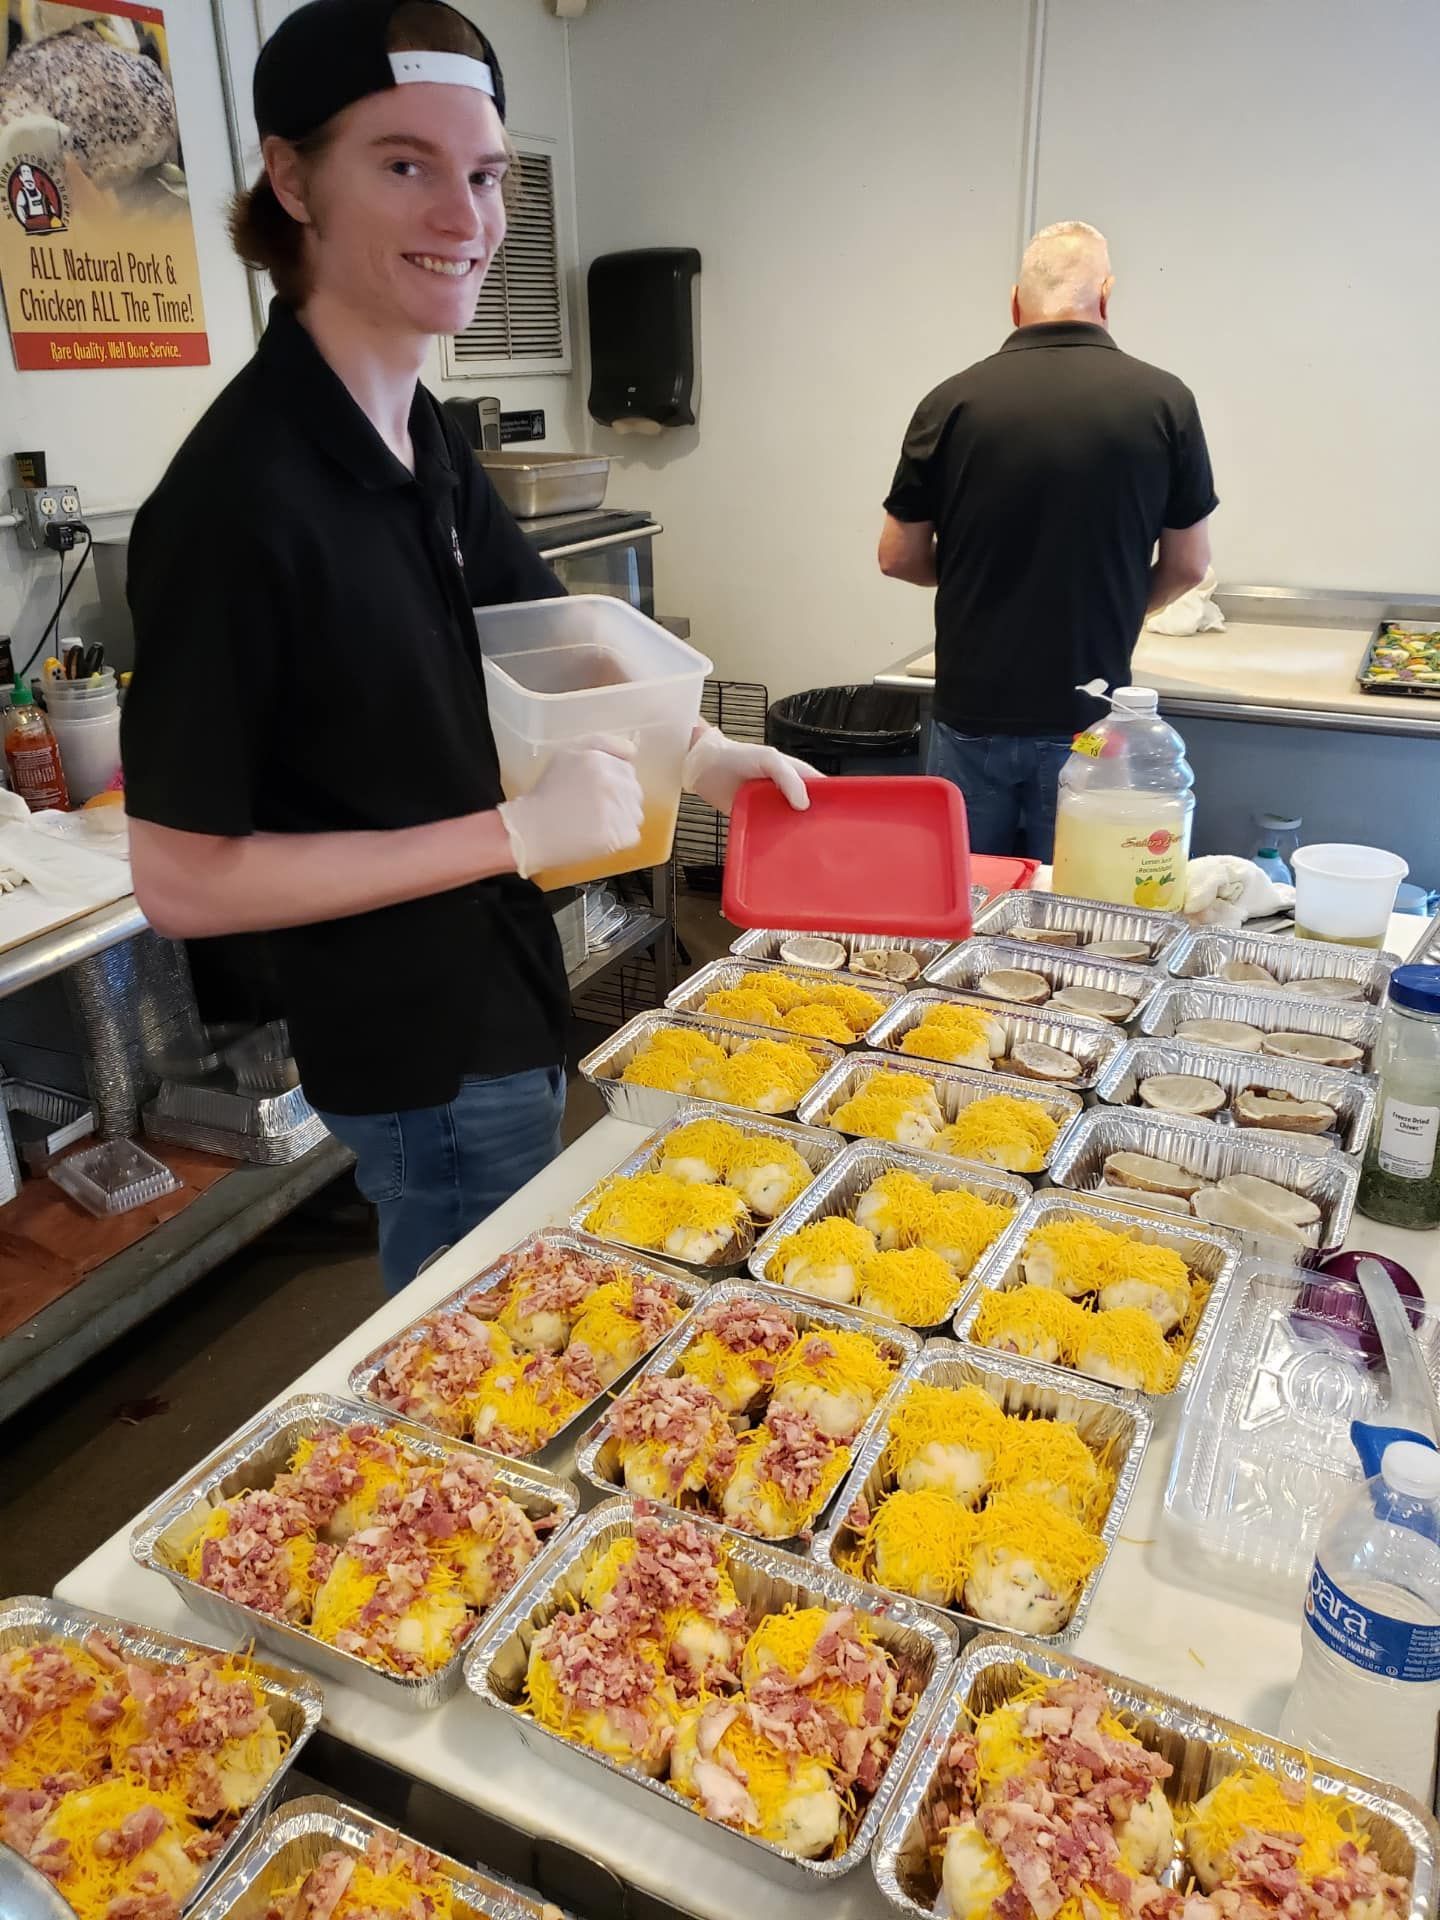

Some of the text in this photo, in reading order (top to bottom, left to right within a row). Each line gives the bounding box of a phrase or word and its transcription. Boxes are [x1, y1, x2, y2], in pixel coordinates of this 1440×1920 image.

[30, 246, 177, 285] ALL Natural Pork &
[20, 288, 195, 323] Chicken ALL The Time!
[50, 341, 182, 362] Rare Quality. Well Done Service.
[1392, 1111, 1430, 1125] Freeze Dried
[1347, 1639, 1376, 1660] WATER
